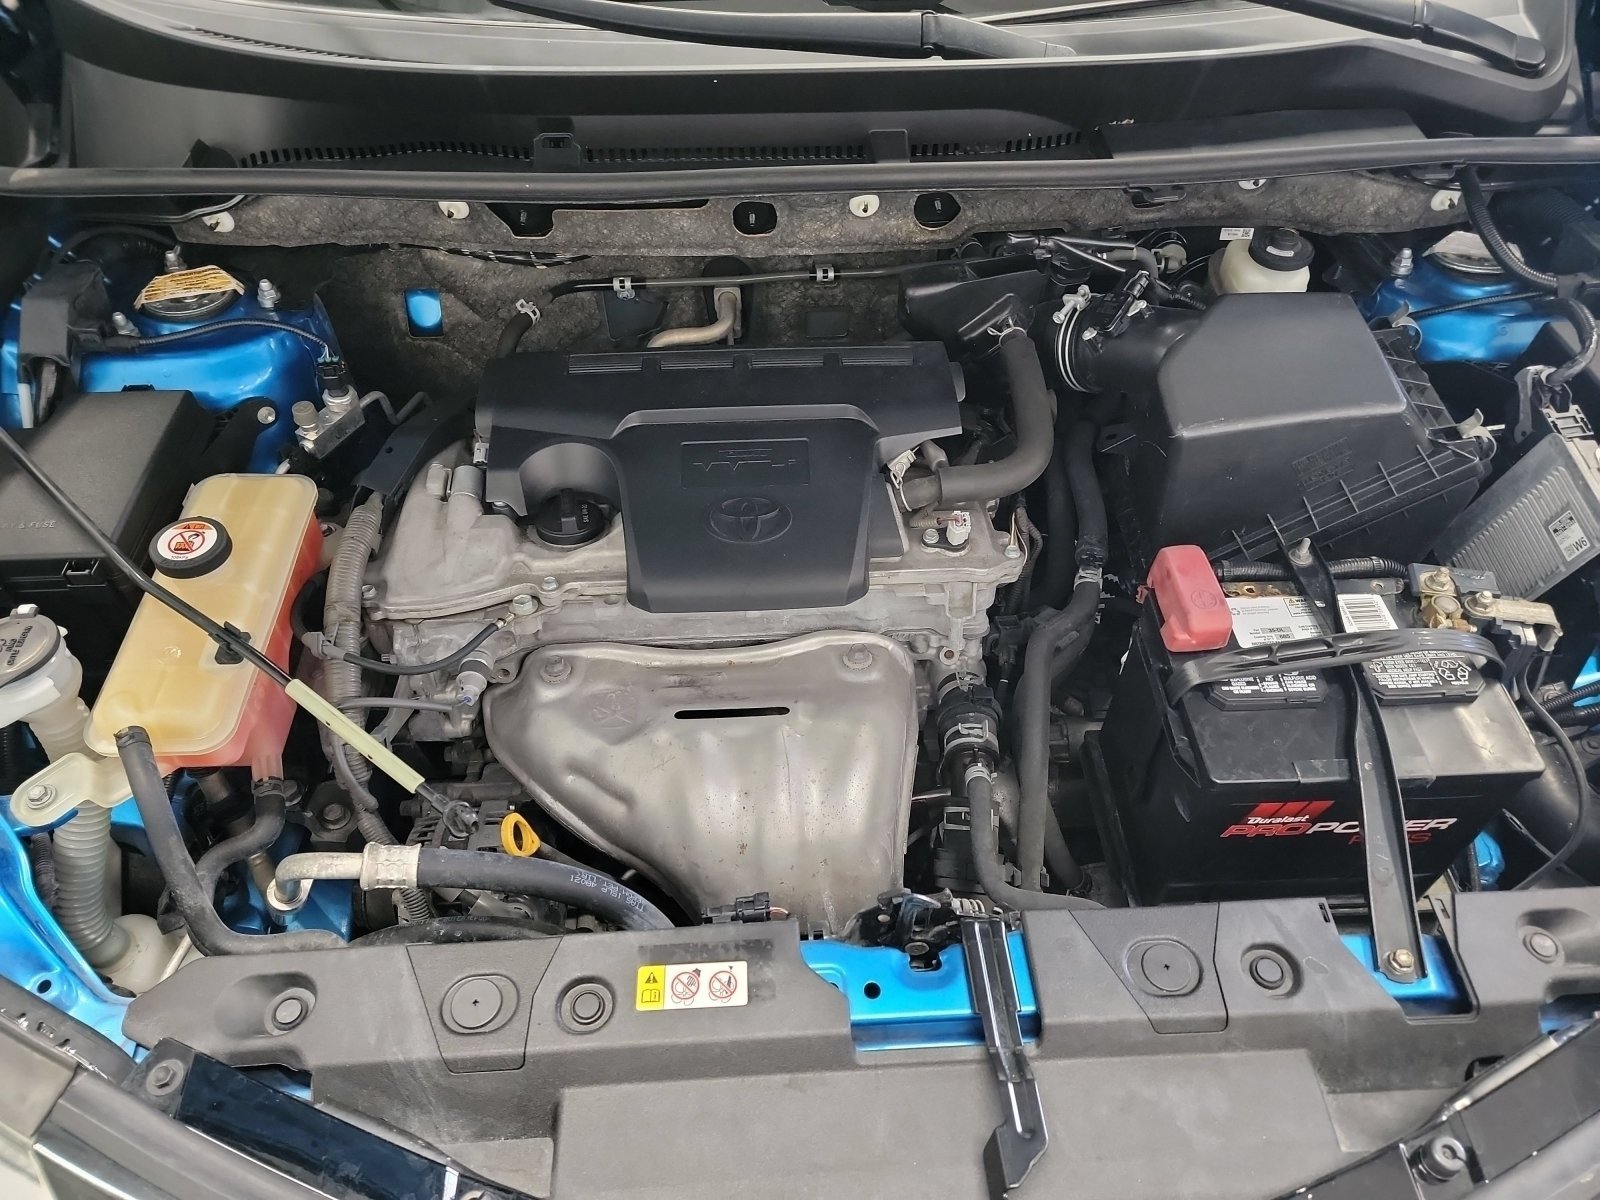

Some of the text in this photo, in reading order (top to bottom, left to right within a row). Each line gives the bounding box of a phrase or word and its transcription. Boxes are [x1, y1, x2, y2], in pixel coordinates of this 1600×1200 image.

[30, 520, 57, 529] FUSE
[1572, 536, 1588, 552] W6
[1247, 814, 1310, 824] Duralast
[1220, 818, 1458, 838] PROPOER
[1348, 832, 1432, 845] PS
